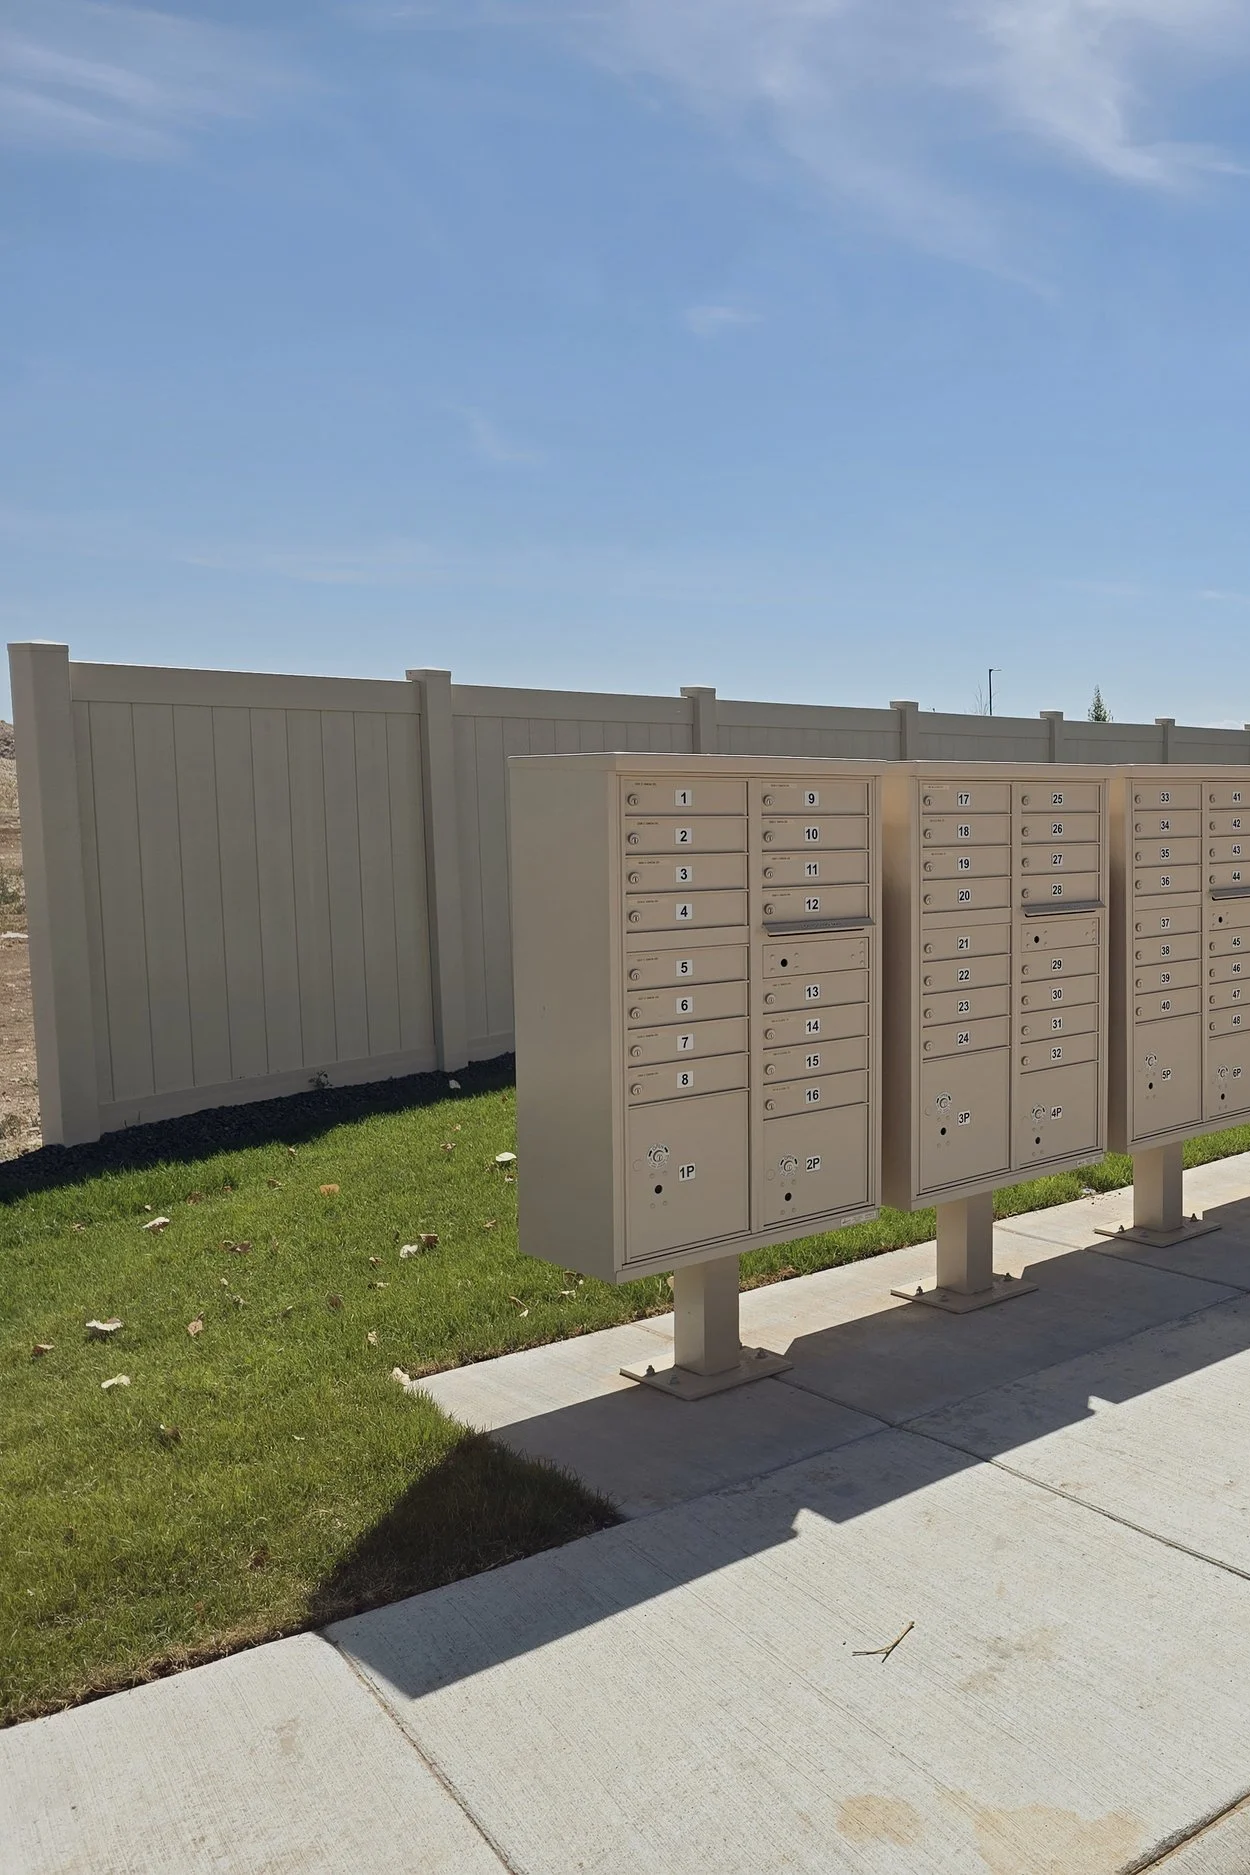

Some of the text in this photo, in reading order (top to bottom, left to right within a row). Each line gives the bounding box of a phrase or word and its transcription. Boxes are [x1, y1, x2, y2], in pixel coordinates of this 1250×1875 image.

[808, 792, 815, 805] 9
[958, 793, 970, 805] 17
[1052, 794, 1063, 804] 25
[1160, 792, 1170, 802] 33
[1233, 792, 1241, 801] 41
[1052, 823, 1063, 834] 26
[1160, 820, 1170, 830] 34
[1232, 818, 1241, 828] 42
[805, 828, 818, 840] 10
[958, 826, 970, 837] 18
[1160, 848, 1170, 858] 35
[1232, 845, 1241, 855] 43
[958, 858, 970, 869] 19
[1052, 854, 1063, 865] 27
[806, 863, 818, 875] 11
[1161, 876, 1170, 886] 36
[1232, 872, 1241, 881] 44
[1052, 884, 1063, 895] 28
[959, 890, 970, 901] 20
[806, 898, 819, 910] 12
[1161, 918, 1170, 928] 37
[958, 938, 969, 949] 21
[1232, 937, 1241, 946] 45
[1161, 945, 1170, 956] 38
[1052, 959, 1062, 970] 29
[1232, 963, 1241, 973] 46
[958, 969, 970, 981] 22
[1161, 973, 1170, 983] 39
[806, 986, 819, 998] 13
[1052, 989, 1062, 1000] 30
[1232, 989, 1241, 999] 47
[958, 1000, 970, 1012] 23
[1161, 1000, 1171, 1011] 40
[1052, 1018, 1062, 1029] 31
[1232, 1015, 1241, 1025] 48
[806, 1020, 819, 1033] 14
[958, 1032, 969, 1044] 24
[1051, 1048, 1062, 1059] 32
[806, 1055, 819, 1068] 15
[1162, 1069, 1172, 1080] 5P
[1232, 1068, 1242, 1078] 6P
[806, 1089, 819, 1102] 16
[958, 1112, 970, 1124] 3P
[1052, 1107, 1062, 1118] 4P
[806, 1157, 820, 1170] 2P
[679, 1165, 695, 1179] 1P
